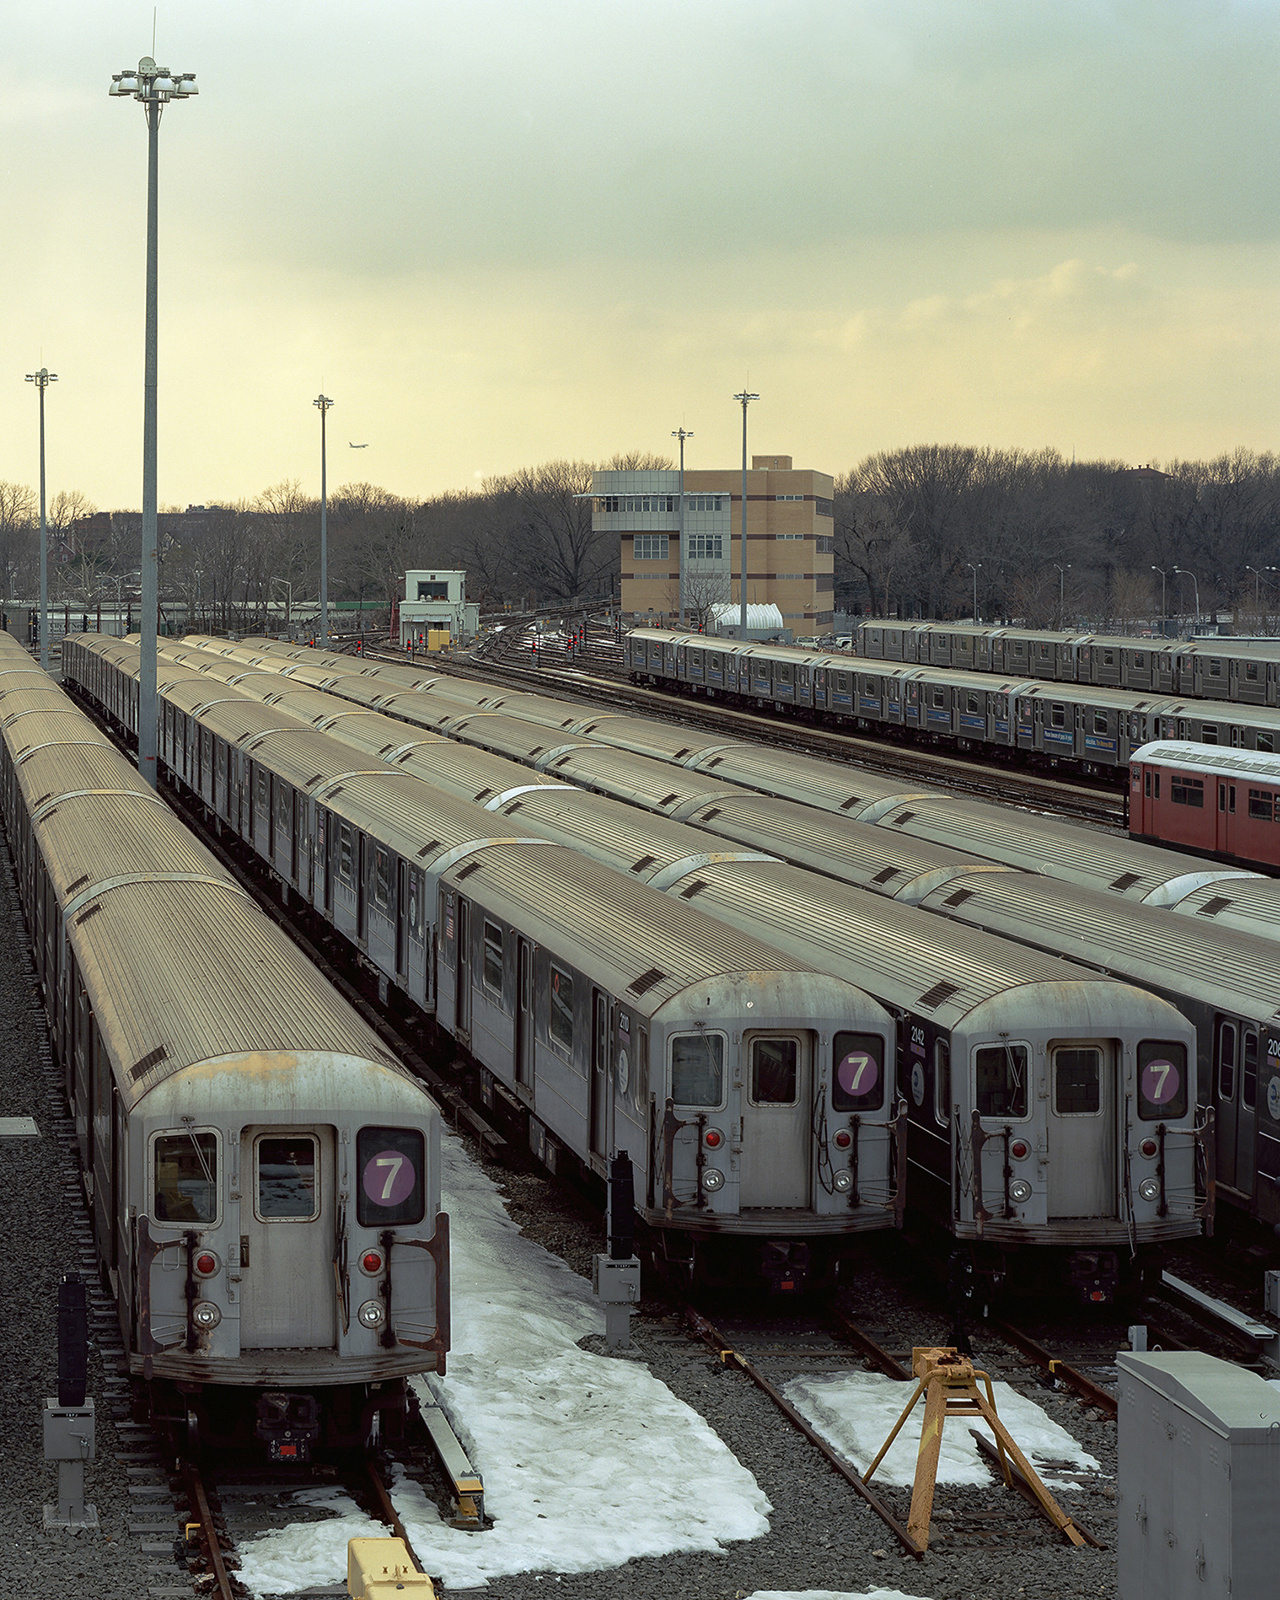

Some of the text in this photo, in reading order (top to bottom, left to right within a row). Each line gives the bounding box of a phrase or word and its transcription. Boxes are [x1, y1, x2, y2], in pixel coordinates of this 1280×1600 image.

[911, 1025, 924, 1046] 2142
[847, 1057, 868, 1090] 7
[1149, 1065, 1170, 1099] 7
[375, 1158, 403, 1199] 7
